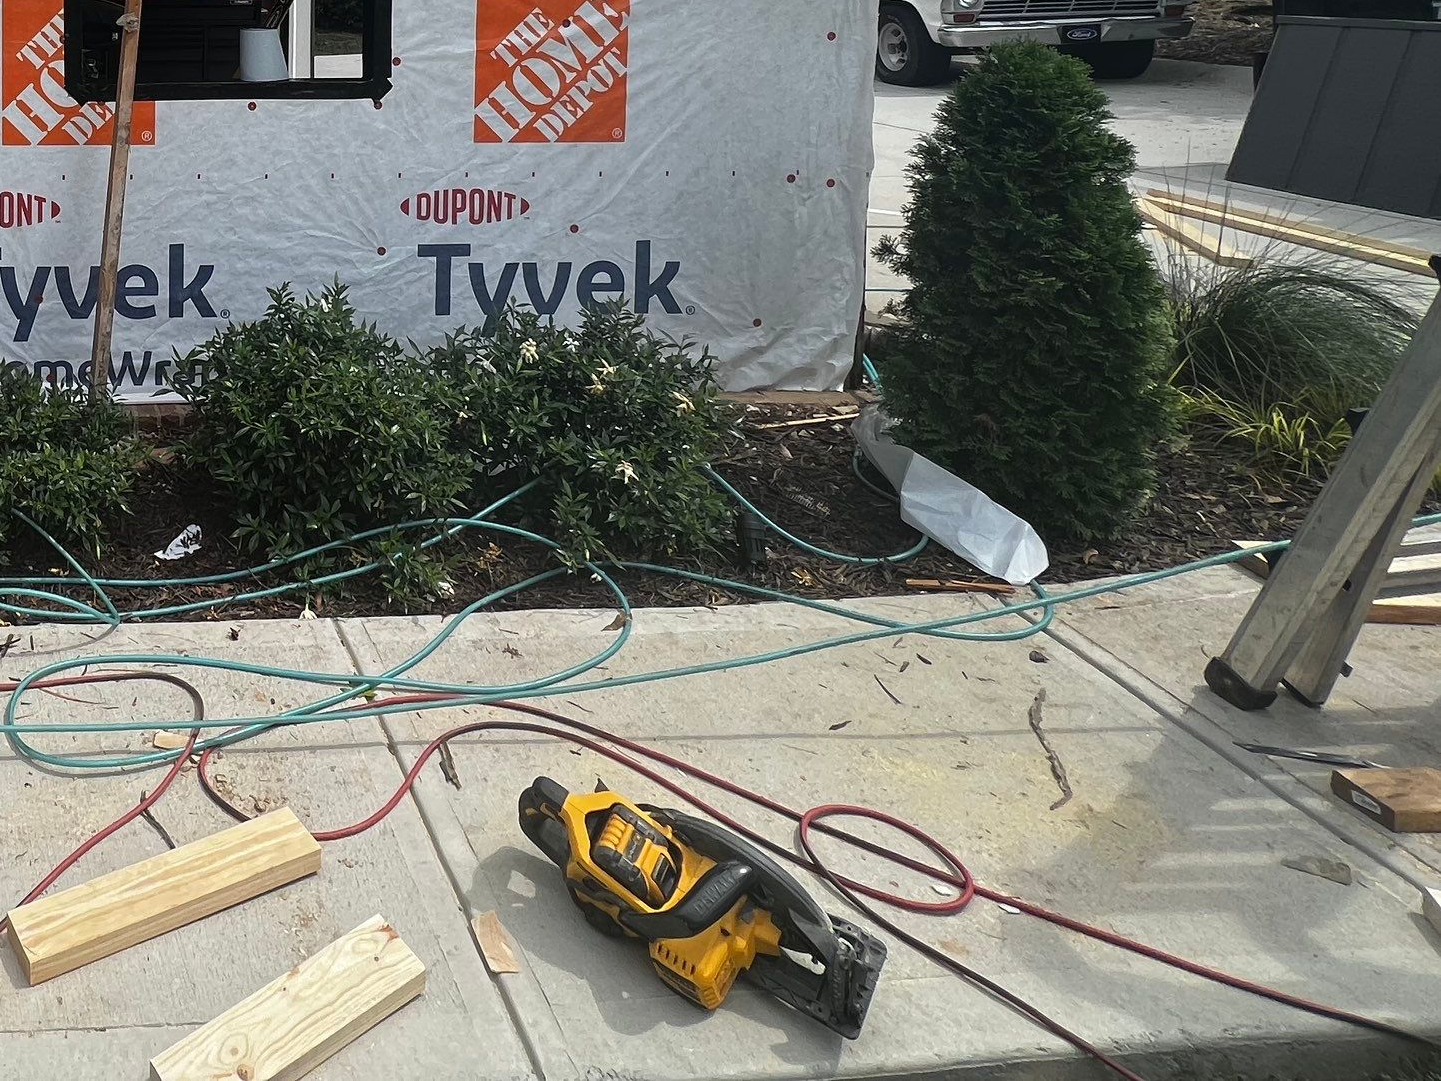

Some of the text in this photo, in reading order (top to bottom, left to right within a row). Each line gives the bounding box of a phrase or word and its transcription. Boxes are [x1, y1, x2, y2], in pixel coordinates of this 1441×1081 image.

[490, 7, 555, 69] THE
[533, 47, 628, 143] DEPOT
[416, 188, 517, 225] DUPONT
[417, 239, 682, 338] Tyvek
